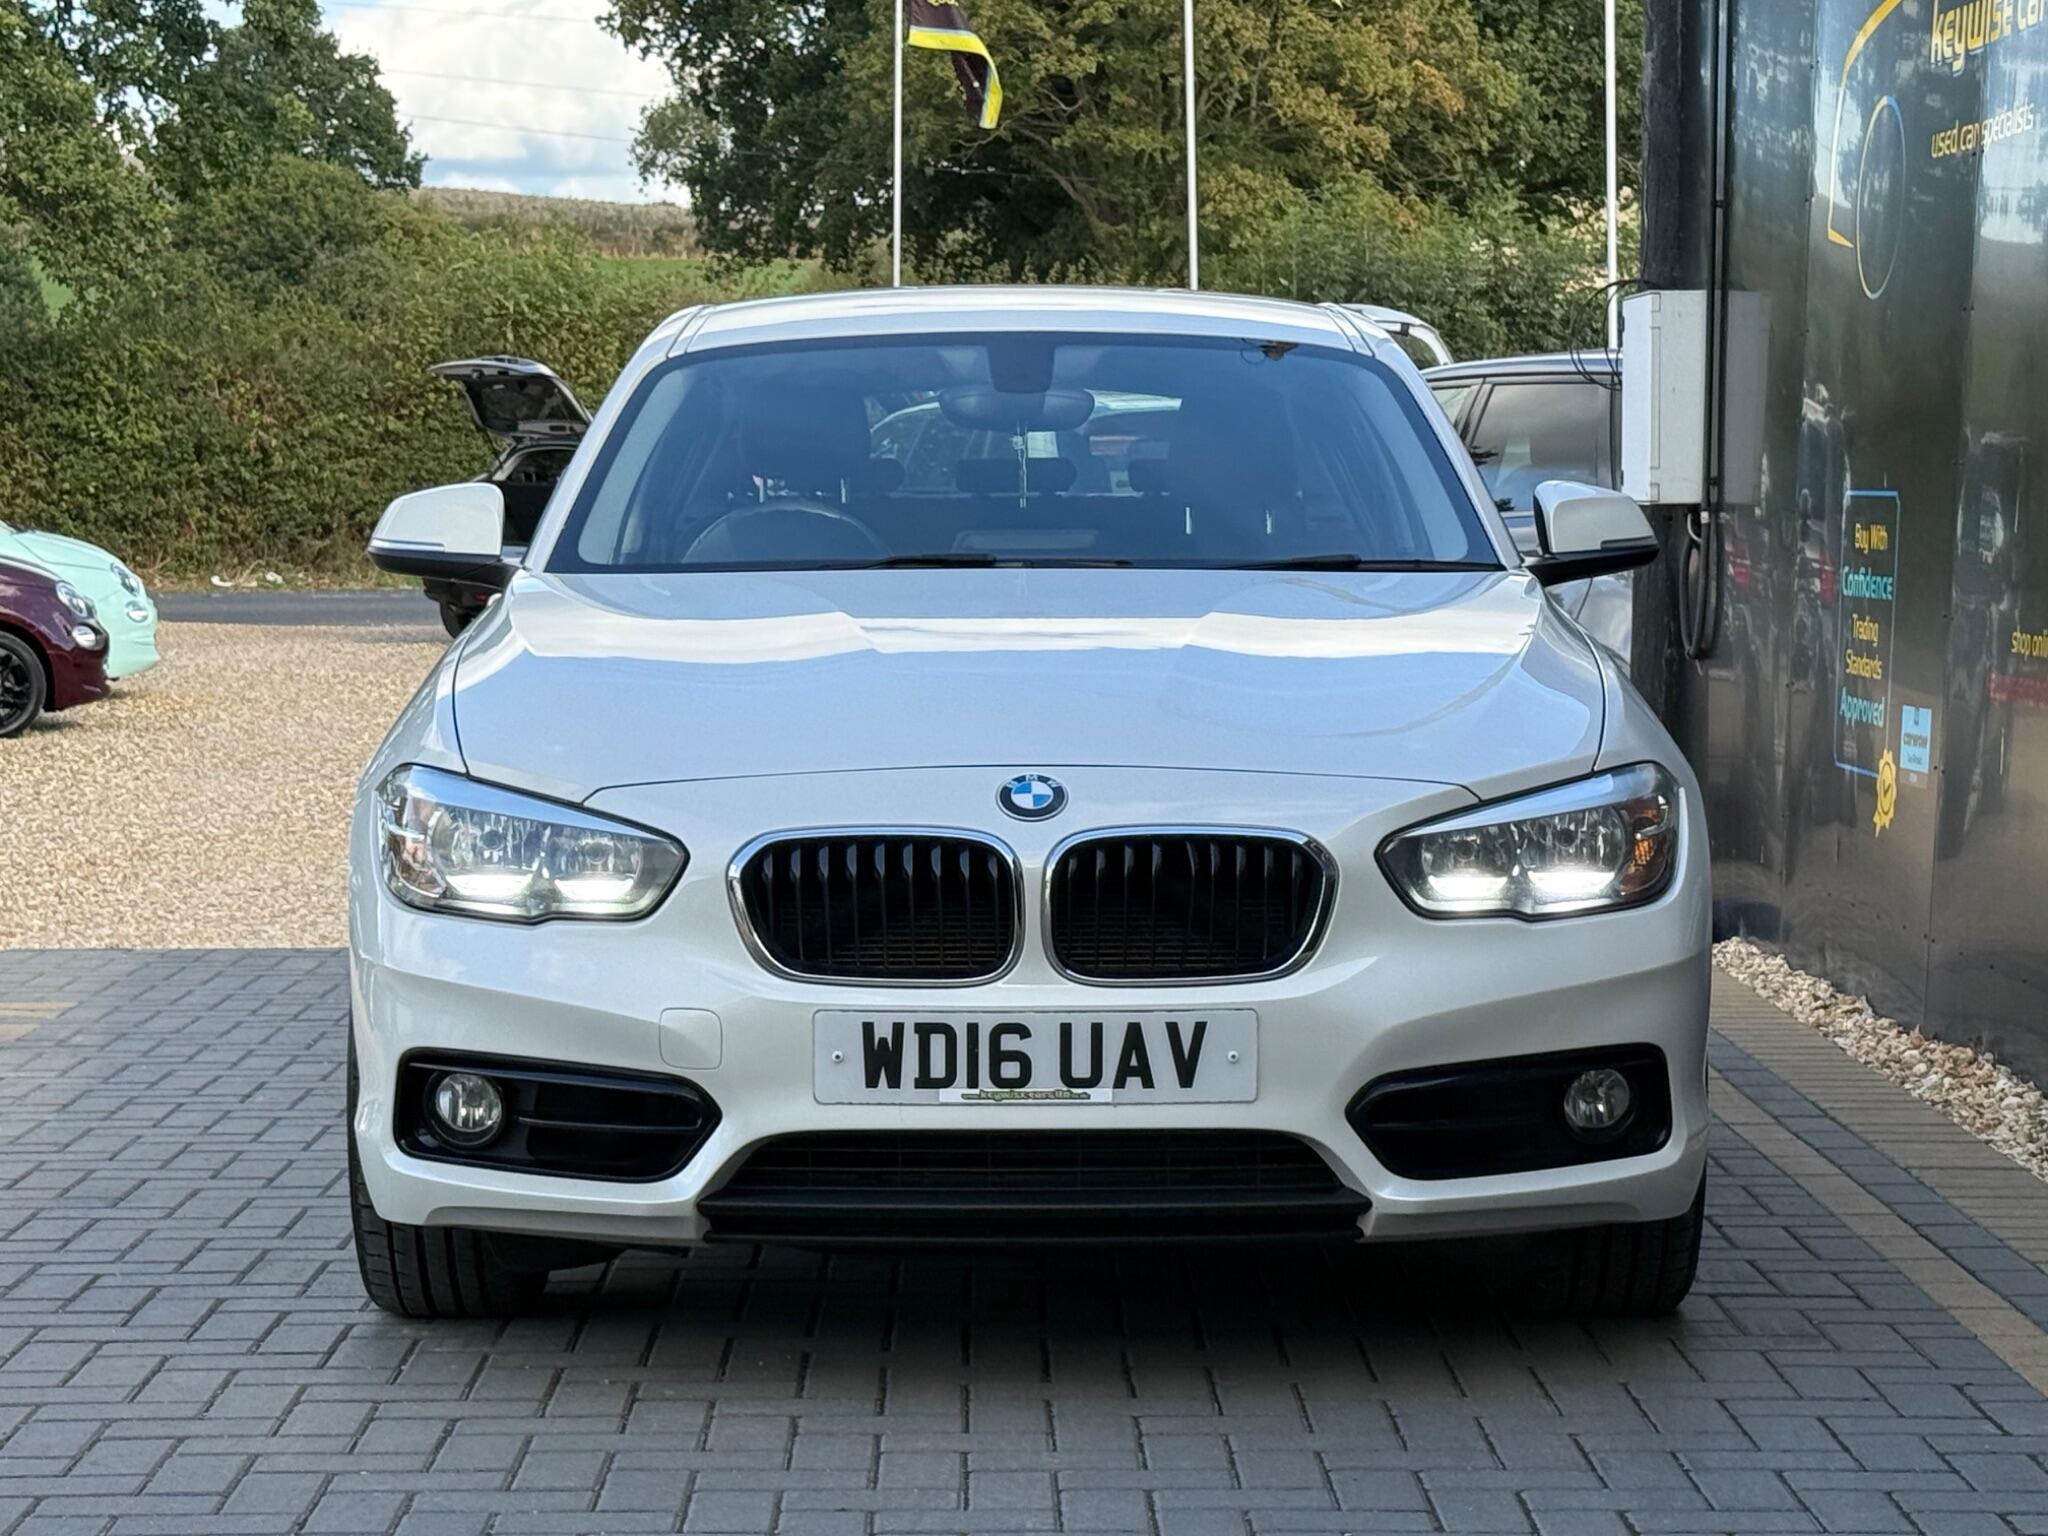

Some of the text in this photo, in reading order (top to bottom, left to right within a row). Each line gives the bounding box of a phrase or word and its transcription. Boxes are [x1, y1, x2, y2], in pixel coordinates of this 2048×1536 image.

[1930, 0, 2012, 73] keywise
[1931, 96, 2034, 158] used car specialists
[1855, 522, 1888, 554] Buy With
[1842, 565, 1893, 600] Confidence
[1852, 613, 1879, 647] Trading
[1845, 649, 1882, 679] Standards
[1840, 687, 1885, 728] Approved
[861, 1021, 1208, 1089] WD16 UAV
